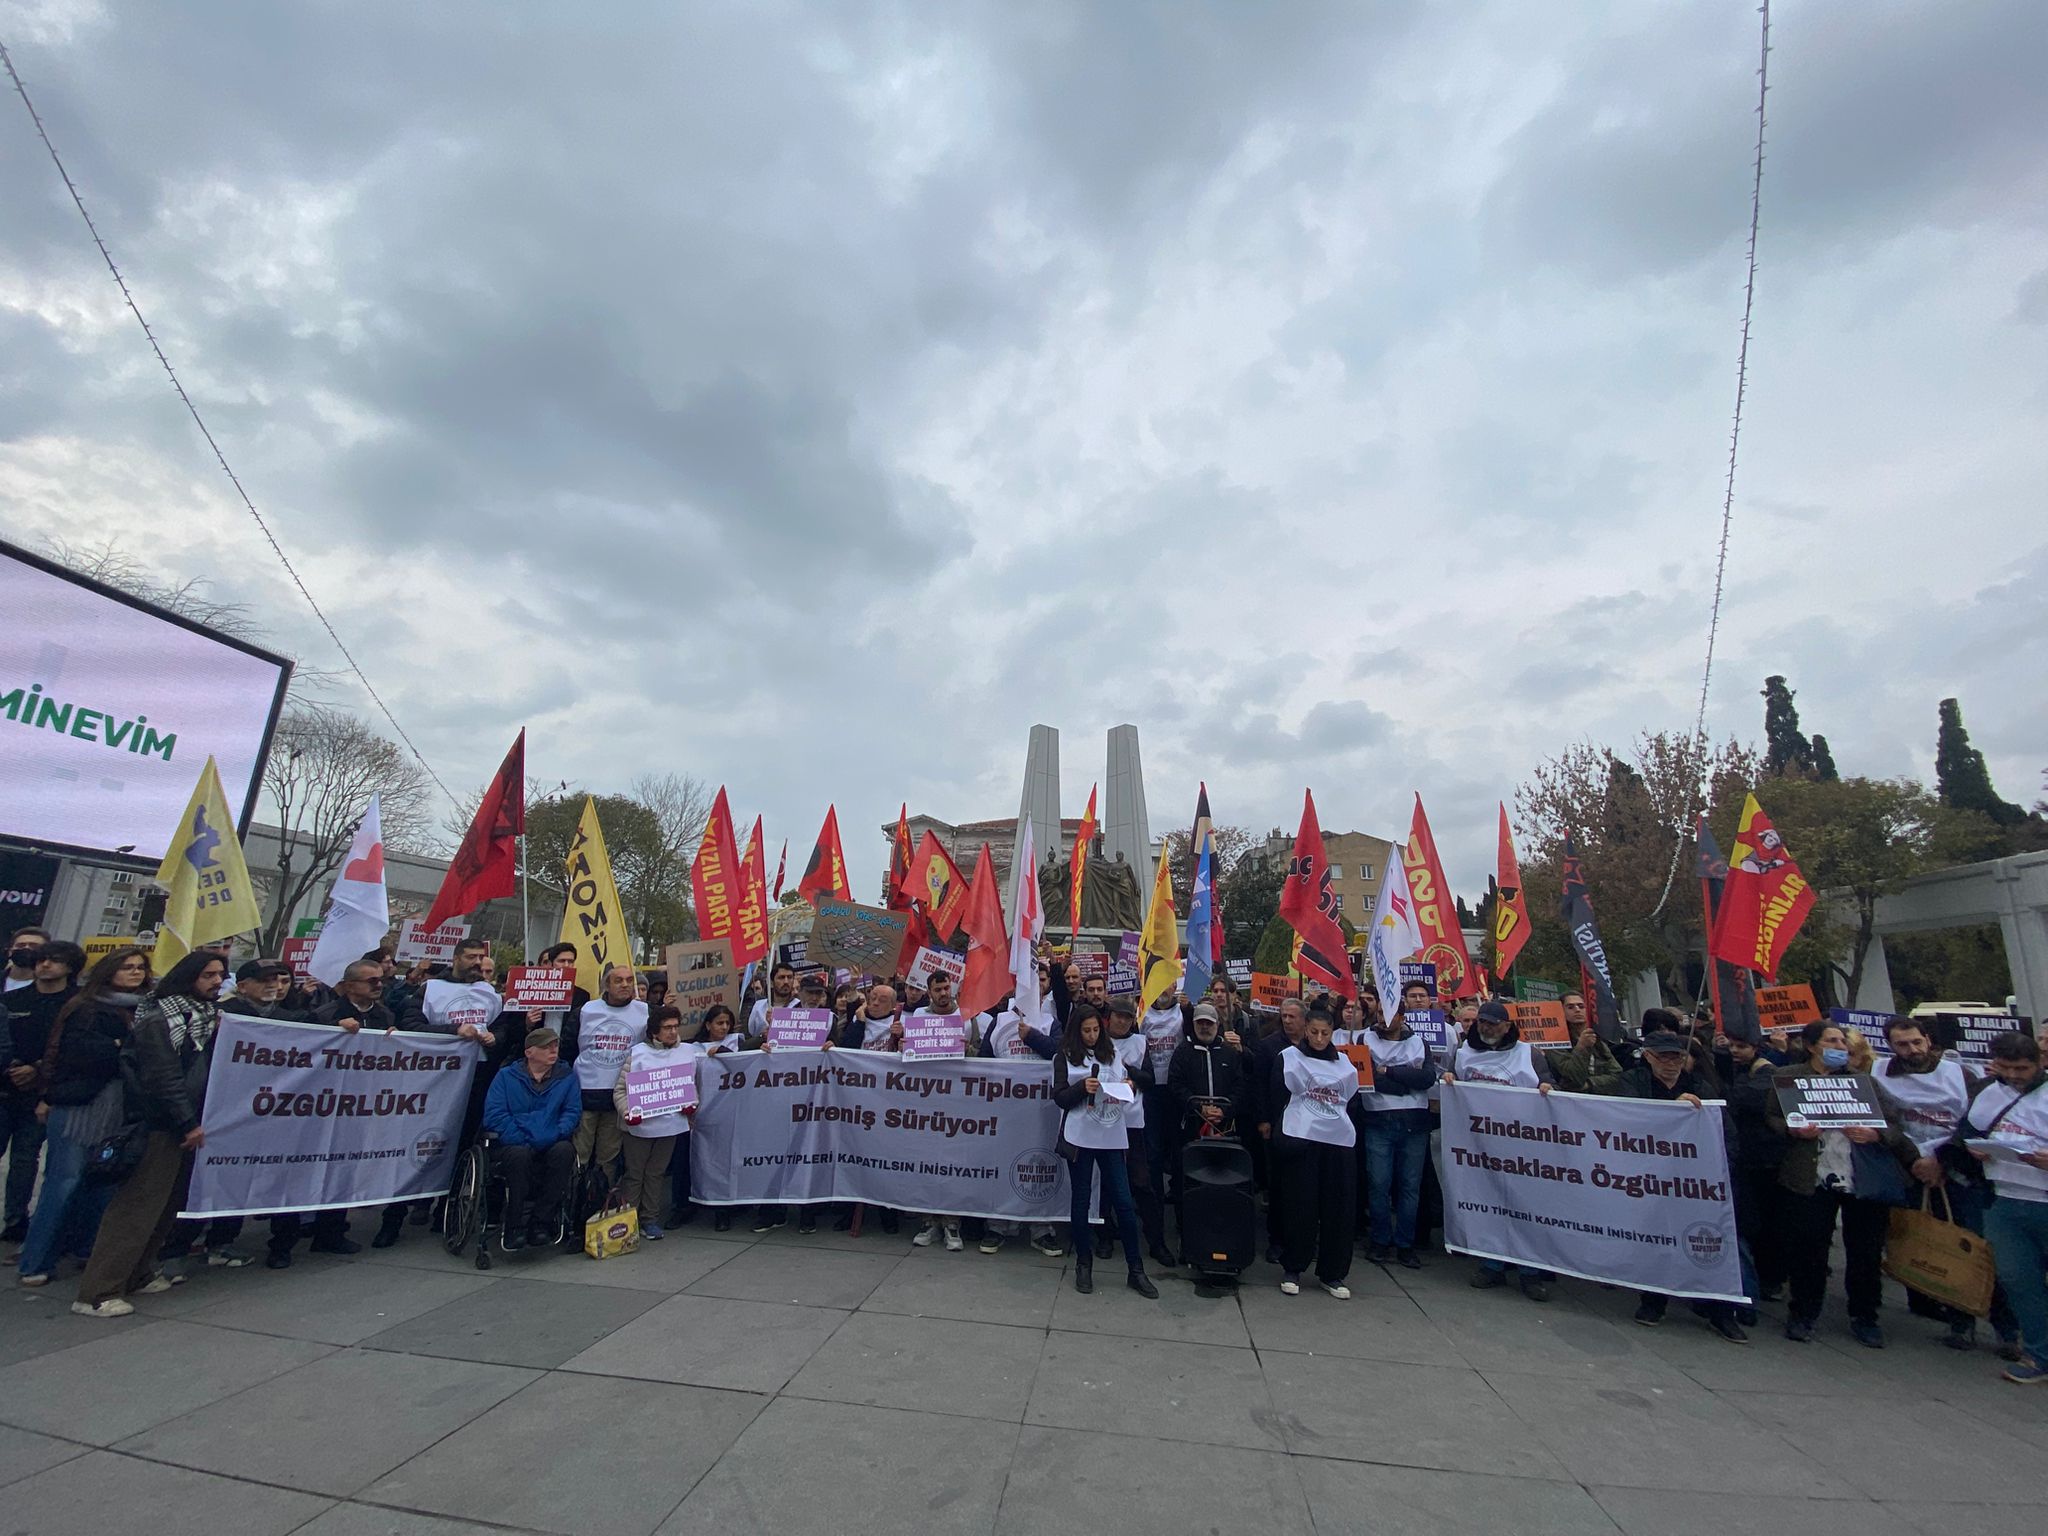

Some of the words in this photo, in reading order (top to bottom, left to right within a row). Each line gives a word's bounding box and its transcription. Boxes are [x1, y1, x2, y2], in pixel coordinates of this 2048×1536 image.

[704, 881, 732, 938] PARTİ
[525, 969, 546, 980] KUYU
[548, 967, 563, 980] TİPİ
[1409, 964, 1423, 975] TİPİ
[514, 979, 572, 990] HAPİSHANELER
[518, 990, 566, 1001] KAPATILSIN!
[1417, 1010, 1431, 1022] TİPİ
[1516, 1005, 1542, 1018] İNFAZ
[1849, 1012, 1872, 1026] KUYU
[1957, 1017, 1971, 1028] 19
[1524, 1029, 1545, 1041] SON!
[231, 1040, 313, 1069] Hasta
[321, 1048, 462, 1072] Tutsaklara
[648, 1067, 671, 1081] TECRİT
[628, 1080, 660, 1095] İNSANLIK
[718, 1071, 746, 1091] 19
[754, 1064, 877, 1089] Aralık'tan
[885, 1070, 952, 1099] Kuyu
[961, 1076, 1054, 1102] Tipleri
[1794, 1078, 1808, 1089] 19
[252, 1086, 429, 1117] ÖZGÜRLÜK!
[640, 1091, 667, 1105] TECRİTE
[668, 1088, 685, 1099] SON!
[1804, 1090, 1858, 1102] UNUTMA,
[1798, 1102, 1872, 1114] UNUTTURMA!
[791, 1102, 876, 1131] Direniş
[884, 1108, 998, 1138] Sürüyor!
[1469, 1114, 1586, 1147] Zindanlar
[1593, 1129, 1698, 1159] Yıkılsın
[206, 1155, 238, 1166] KUYU
[242, 1153, 283, 1165] TİPLERİ
[286, 1151, 345, 1164] KAPATILSIN
[743, 1155, 784, 1167] KUYU
[786, 1150, 833, 1165] TİPLERİ
[837, 1153, 916, 1174] KAPATILSIN
[919, 1161, 999, 1180] İNİSİYATİFİ
[1451, 1147, 1583, 1185] Tutsaklara
[1590, 1163, 1727, 1202] Özgürlük!
[1458, 1201, 1489, 1214] KUYU
[1491, 1205, 1532, 1222] TİPLERİ
[1535, 1216, 1604, 1235] KAPATILSIN
[1607, 1224, 1678, 1248] İNİSİYATİFİ
